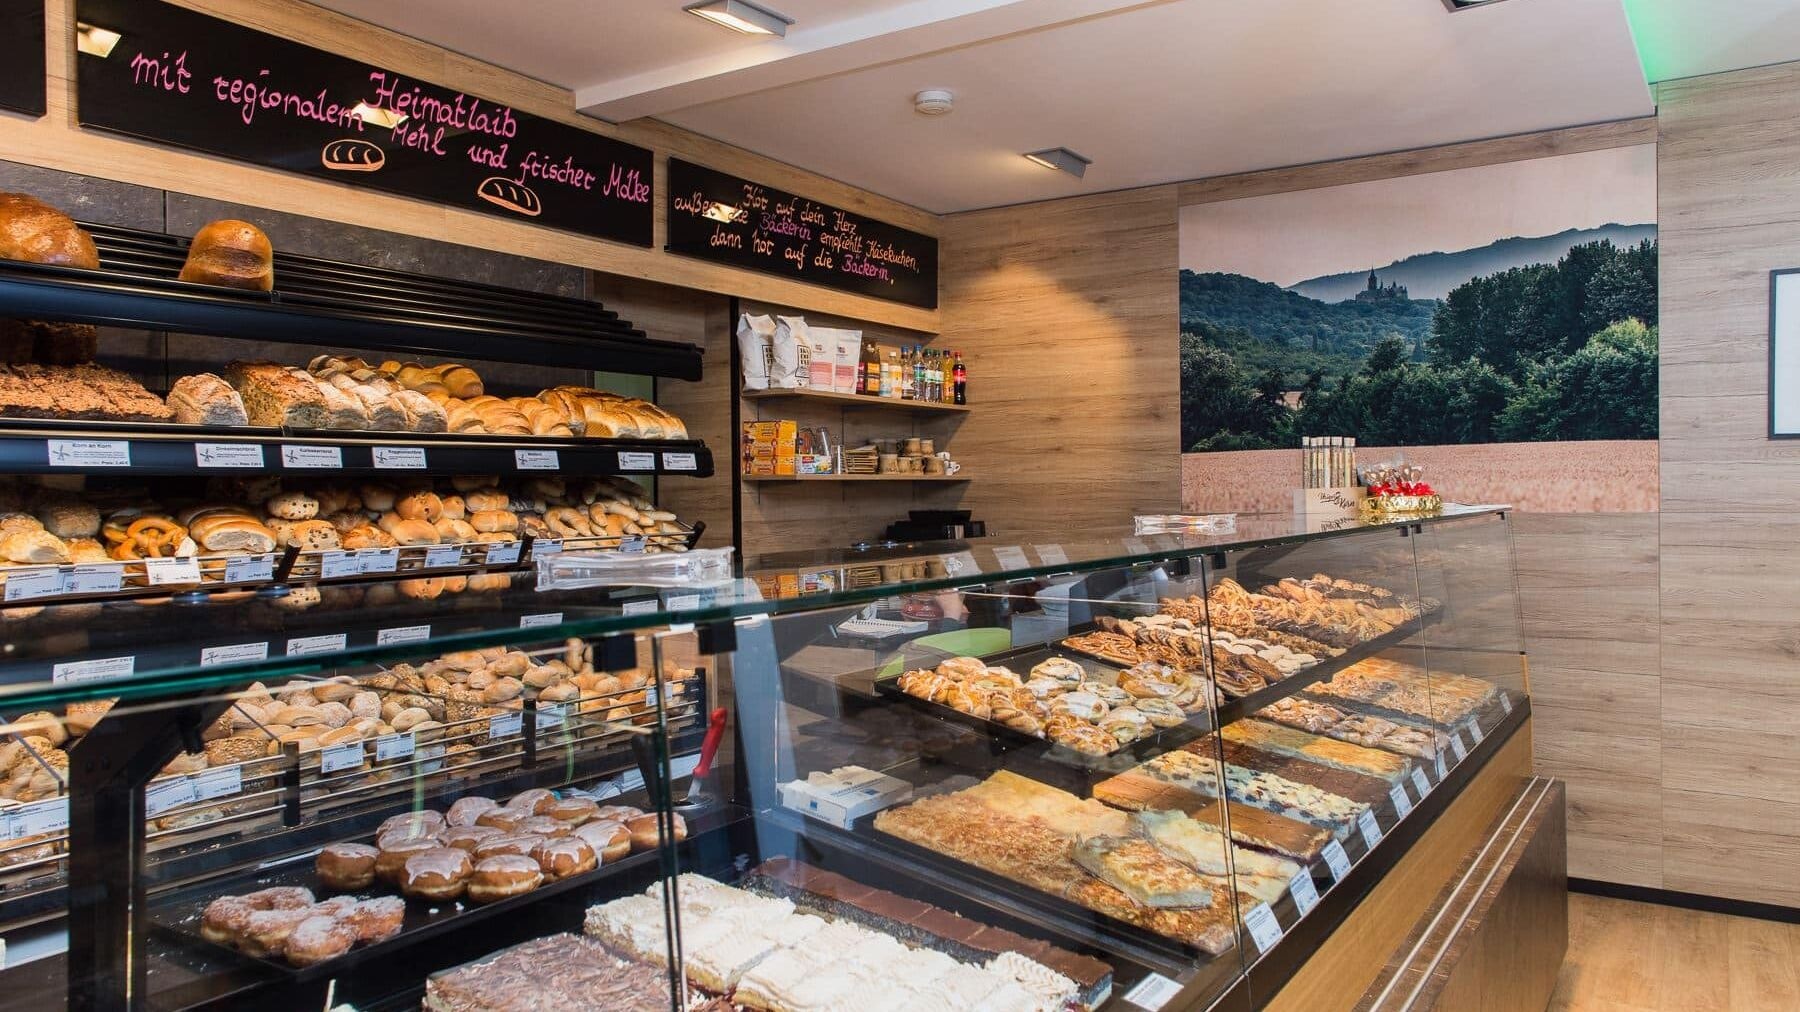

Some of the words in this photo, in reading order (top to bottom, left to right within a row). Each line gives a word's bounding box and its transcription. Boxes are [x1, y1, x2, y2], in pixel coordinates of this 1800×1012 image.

[131, 50, 192, 94] mit
[212, 69, 366, 132] regionalem
[391, 122, 446, 156] Mehl
[467, 144, 508, 170] und
[515, 151, 597, 190] frischer
[603, 162, 651, 203] Molke
[362, 72, 518, 138] Heimatlaib
[743, 184, 769, 211] Hör
[775, 197, 800, 223] auf
[800, 201, 826, 227] dein
[832, 210, 857, 236] Herz
[760, 212, 812, 241] Bäckerin
[820, 232, 863, 255] empfiehlt
[710, 224, 743, 249] dann
[751, 229, 775, 256] hör
[784, 243, 809, 270] auf
[814, 247, 834, 270] die
